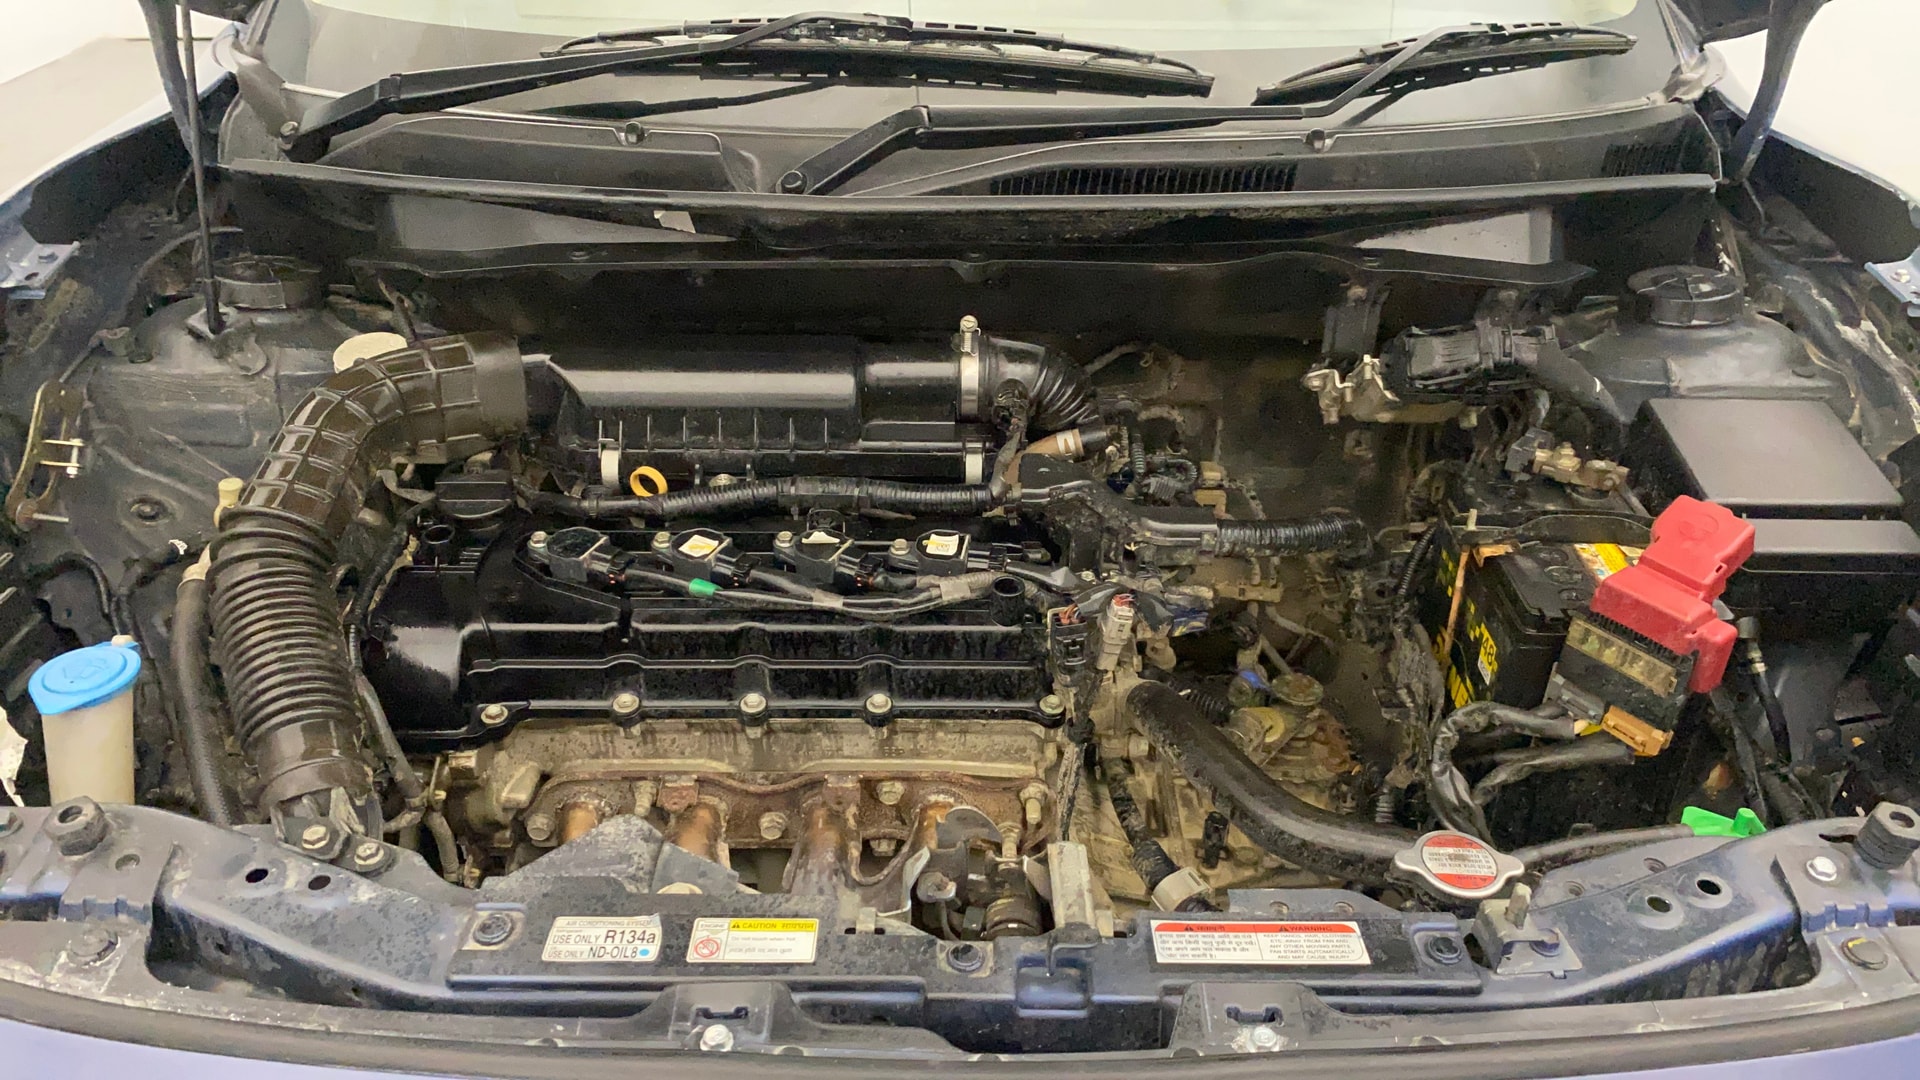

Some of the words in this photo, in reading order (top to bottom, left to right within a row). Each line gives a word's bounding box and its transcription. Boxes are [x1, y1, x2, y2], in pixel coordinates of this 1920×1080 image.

[552, 934, 572, 944] USE
[573, 934, 602, 944] ONLY
[603, 929, 656, 944] R134a
[548, 950, 564, 958] USE
[564, 950, 585, 958] ONLY
[587, 946, 639, 958] ND-OIL8
